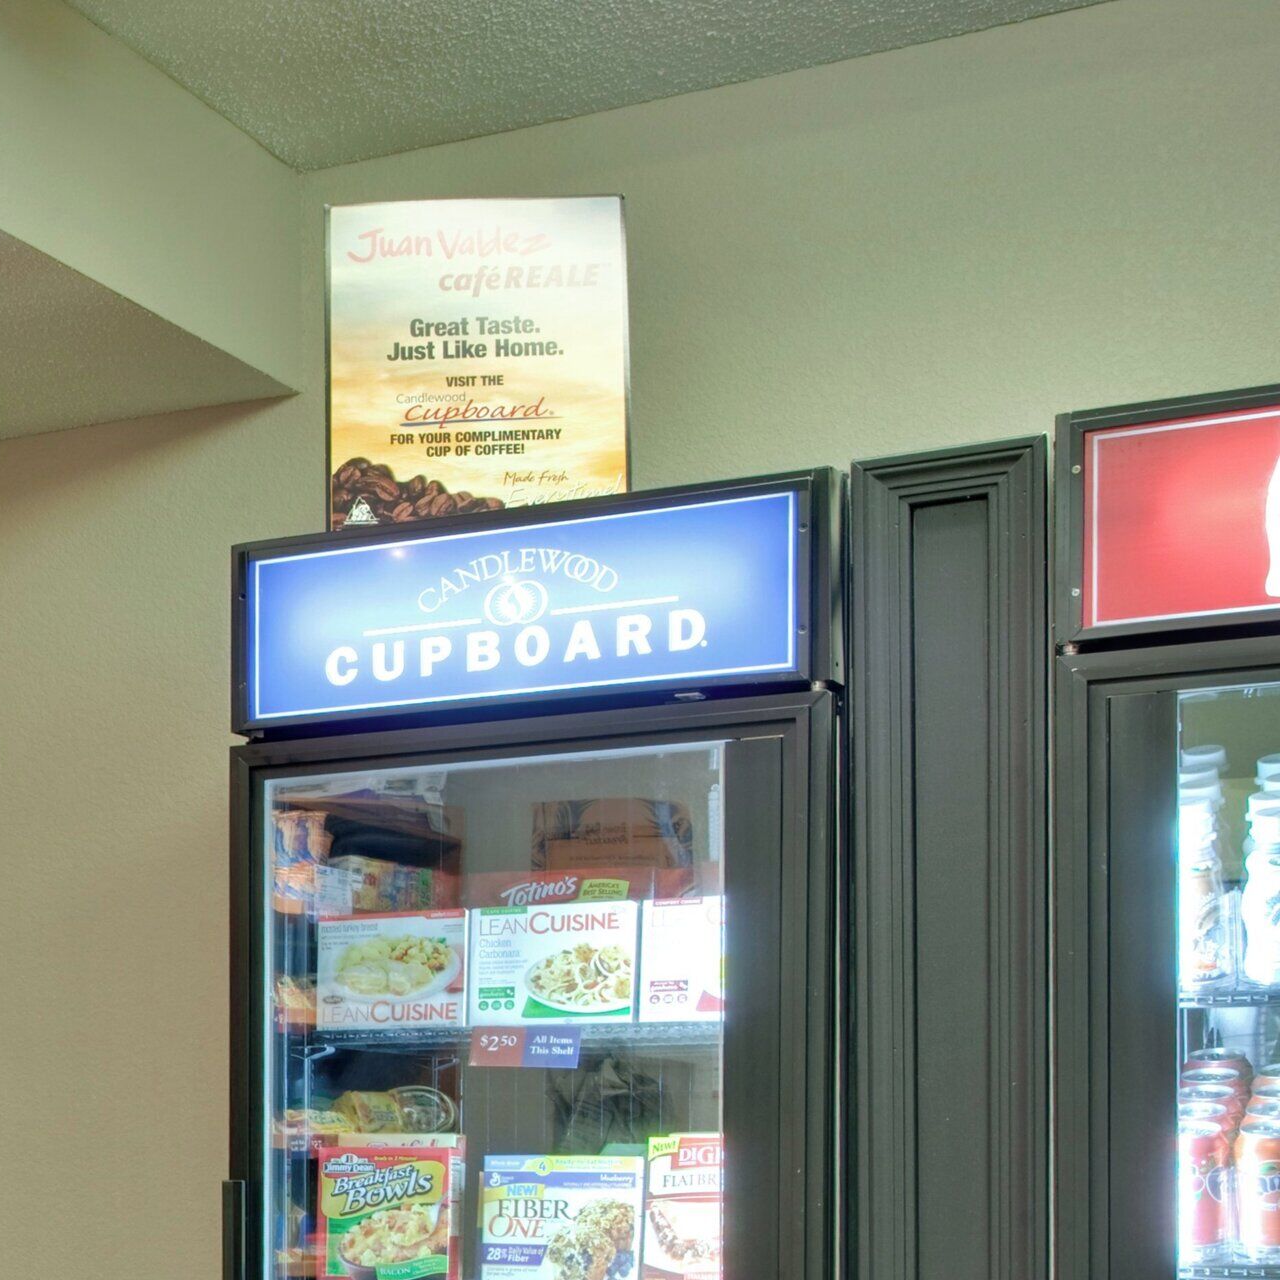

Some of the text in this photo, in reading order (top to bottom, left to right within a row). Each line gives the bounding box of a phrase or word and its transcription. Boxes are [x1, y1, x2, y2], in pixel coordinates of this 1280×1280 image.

[346, 225, 553, 264] Juan Valdez
[409, 316, 541, 338] Great Taste.
[386, 338, 565, 362] Just Like Home.
[445, 374, 504, 388] VISIT THE
[395, 392, 467, 405] Candlewood
[404, 396, 550, 429] Cupboard
[389, 428, 563, 445] FOR YOUR COMPLIMENTARY
[425, 444, 525, 458] CUP OF COFFEE!
[503, 470, 570, 485] Made Fresh
[416, 546, 621, 614] CANDLEWOOD
[324, 607, 705, 686] CUPBOARD
[478, 911, 621, 936] LEAN CUISINE
[321, 1000, 458, 1024] LEAN CUISINE
[331, 1164, 415, 1197] Breakfast
[506, 1184, 539, 1197] NEW!
[497, 1199, 570, 1219] FIBER
[488, 1214, 545, 1238] ONE
[380, 1266, 411, 1276] BACON
